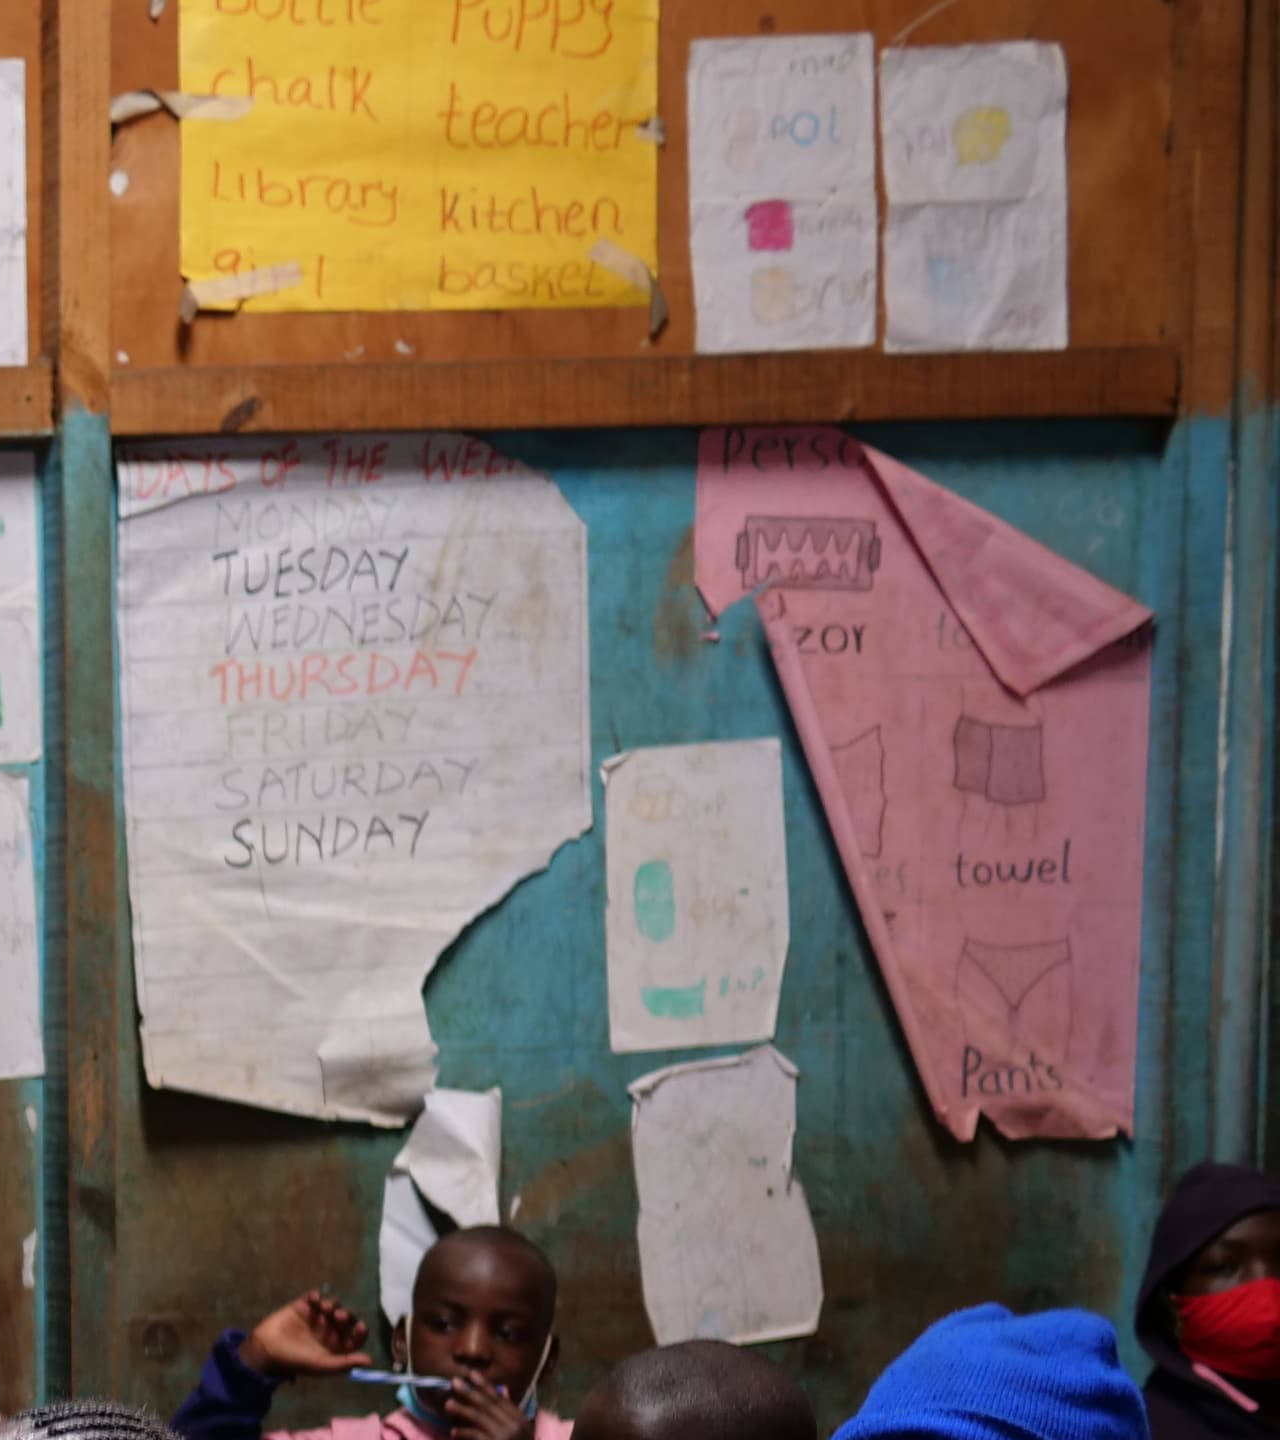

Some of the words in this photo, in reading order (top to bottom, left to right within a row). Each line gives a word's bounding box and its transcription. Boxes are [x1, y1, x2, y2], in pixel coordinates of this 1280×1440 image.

[439, 82, 642, 151] teacher
[134, 454, 237, 500] DAYS
[260, 445, 302, 488] OF
[324, 444, 388, 485] THE
[214, 493, 401, 548] MONDAY
[212, 546, 410, 599] TUESDAY
[225, 592, 496, 655] WEDNESDAY
[210, 647, 478, 704] THURSDAY
[224, 705, 416, 756] FRIDAY
[216, 756, 480, 811] SATURDAY
[224, 809, 429, 869] SUNDAY
[954, 838, 1073, 888] towel
[960, 1045, 1065, 1099] Pants
